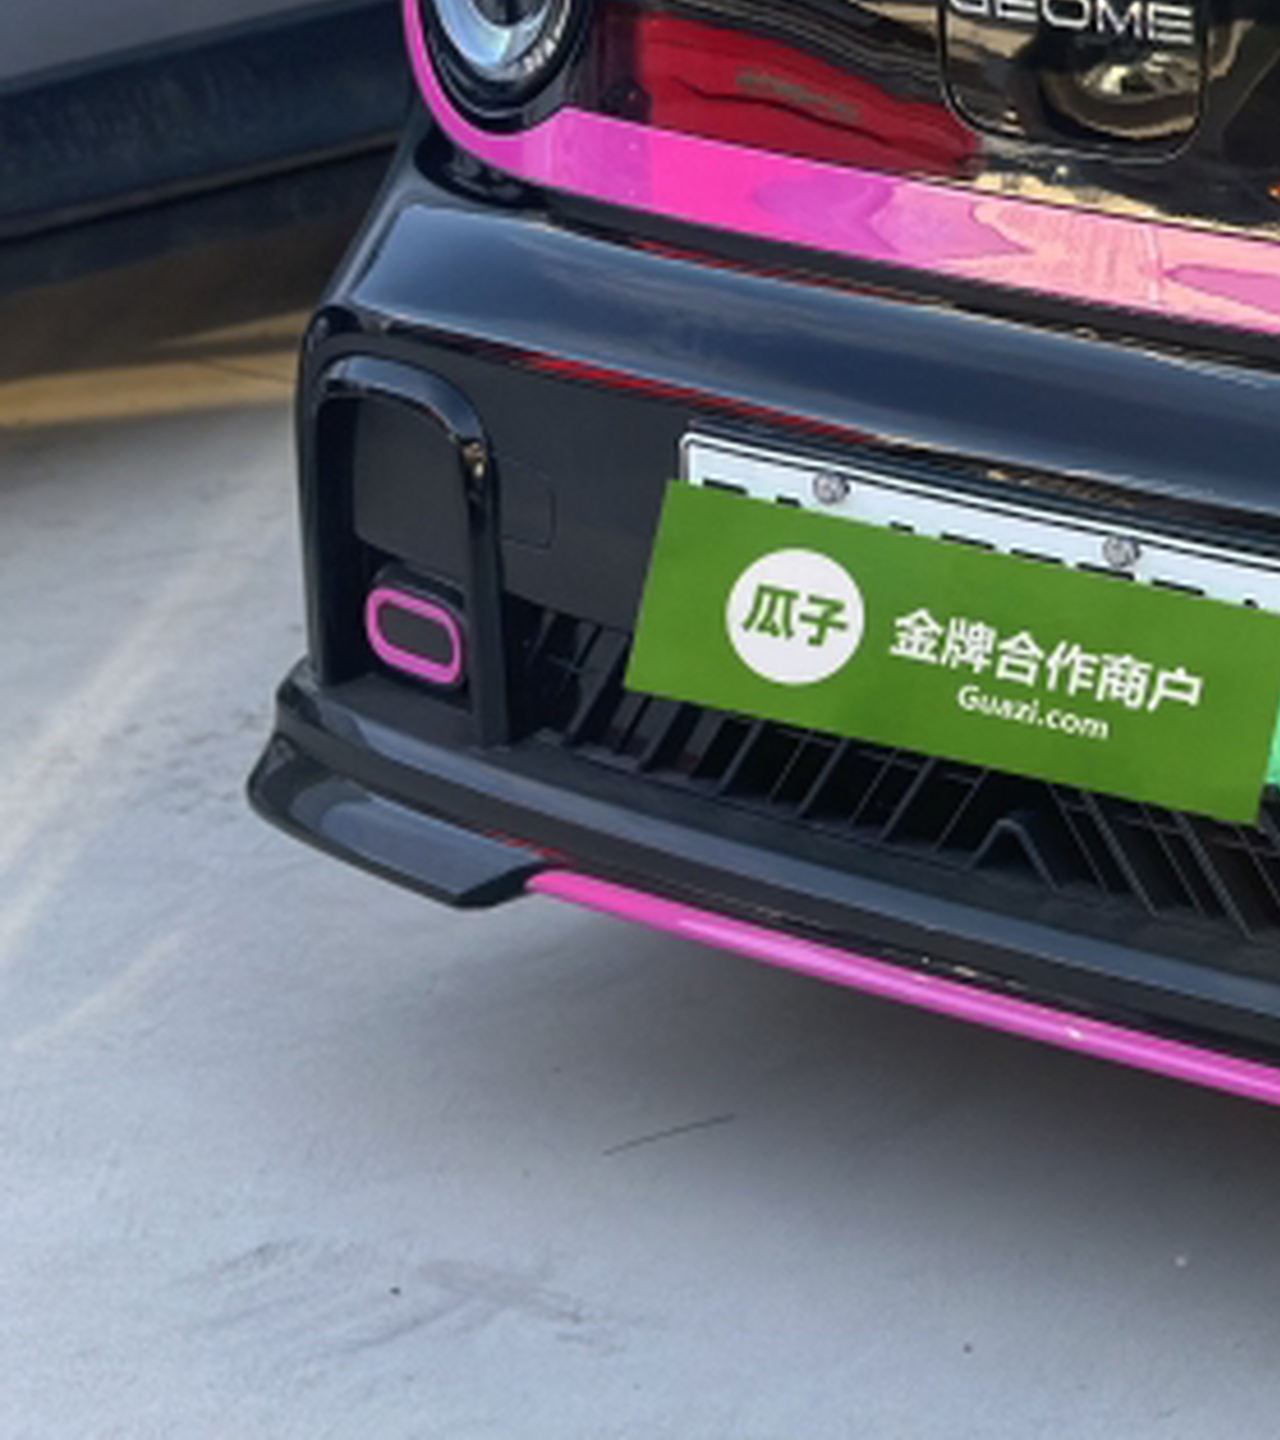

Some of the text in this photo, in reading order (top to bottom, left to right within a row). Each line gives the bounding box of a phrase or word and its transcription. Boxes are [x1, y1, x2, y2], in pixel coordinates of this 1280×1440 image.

[742, 585, 848, 647] 瓜子
[888, 606, 1203, 713] 金牌合作商户
[956, 683, 1110, 740] Guazi.com
